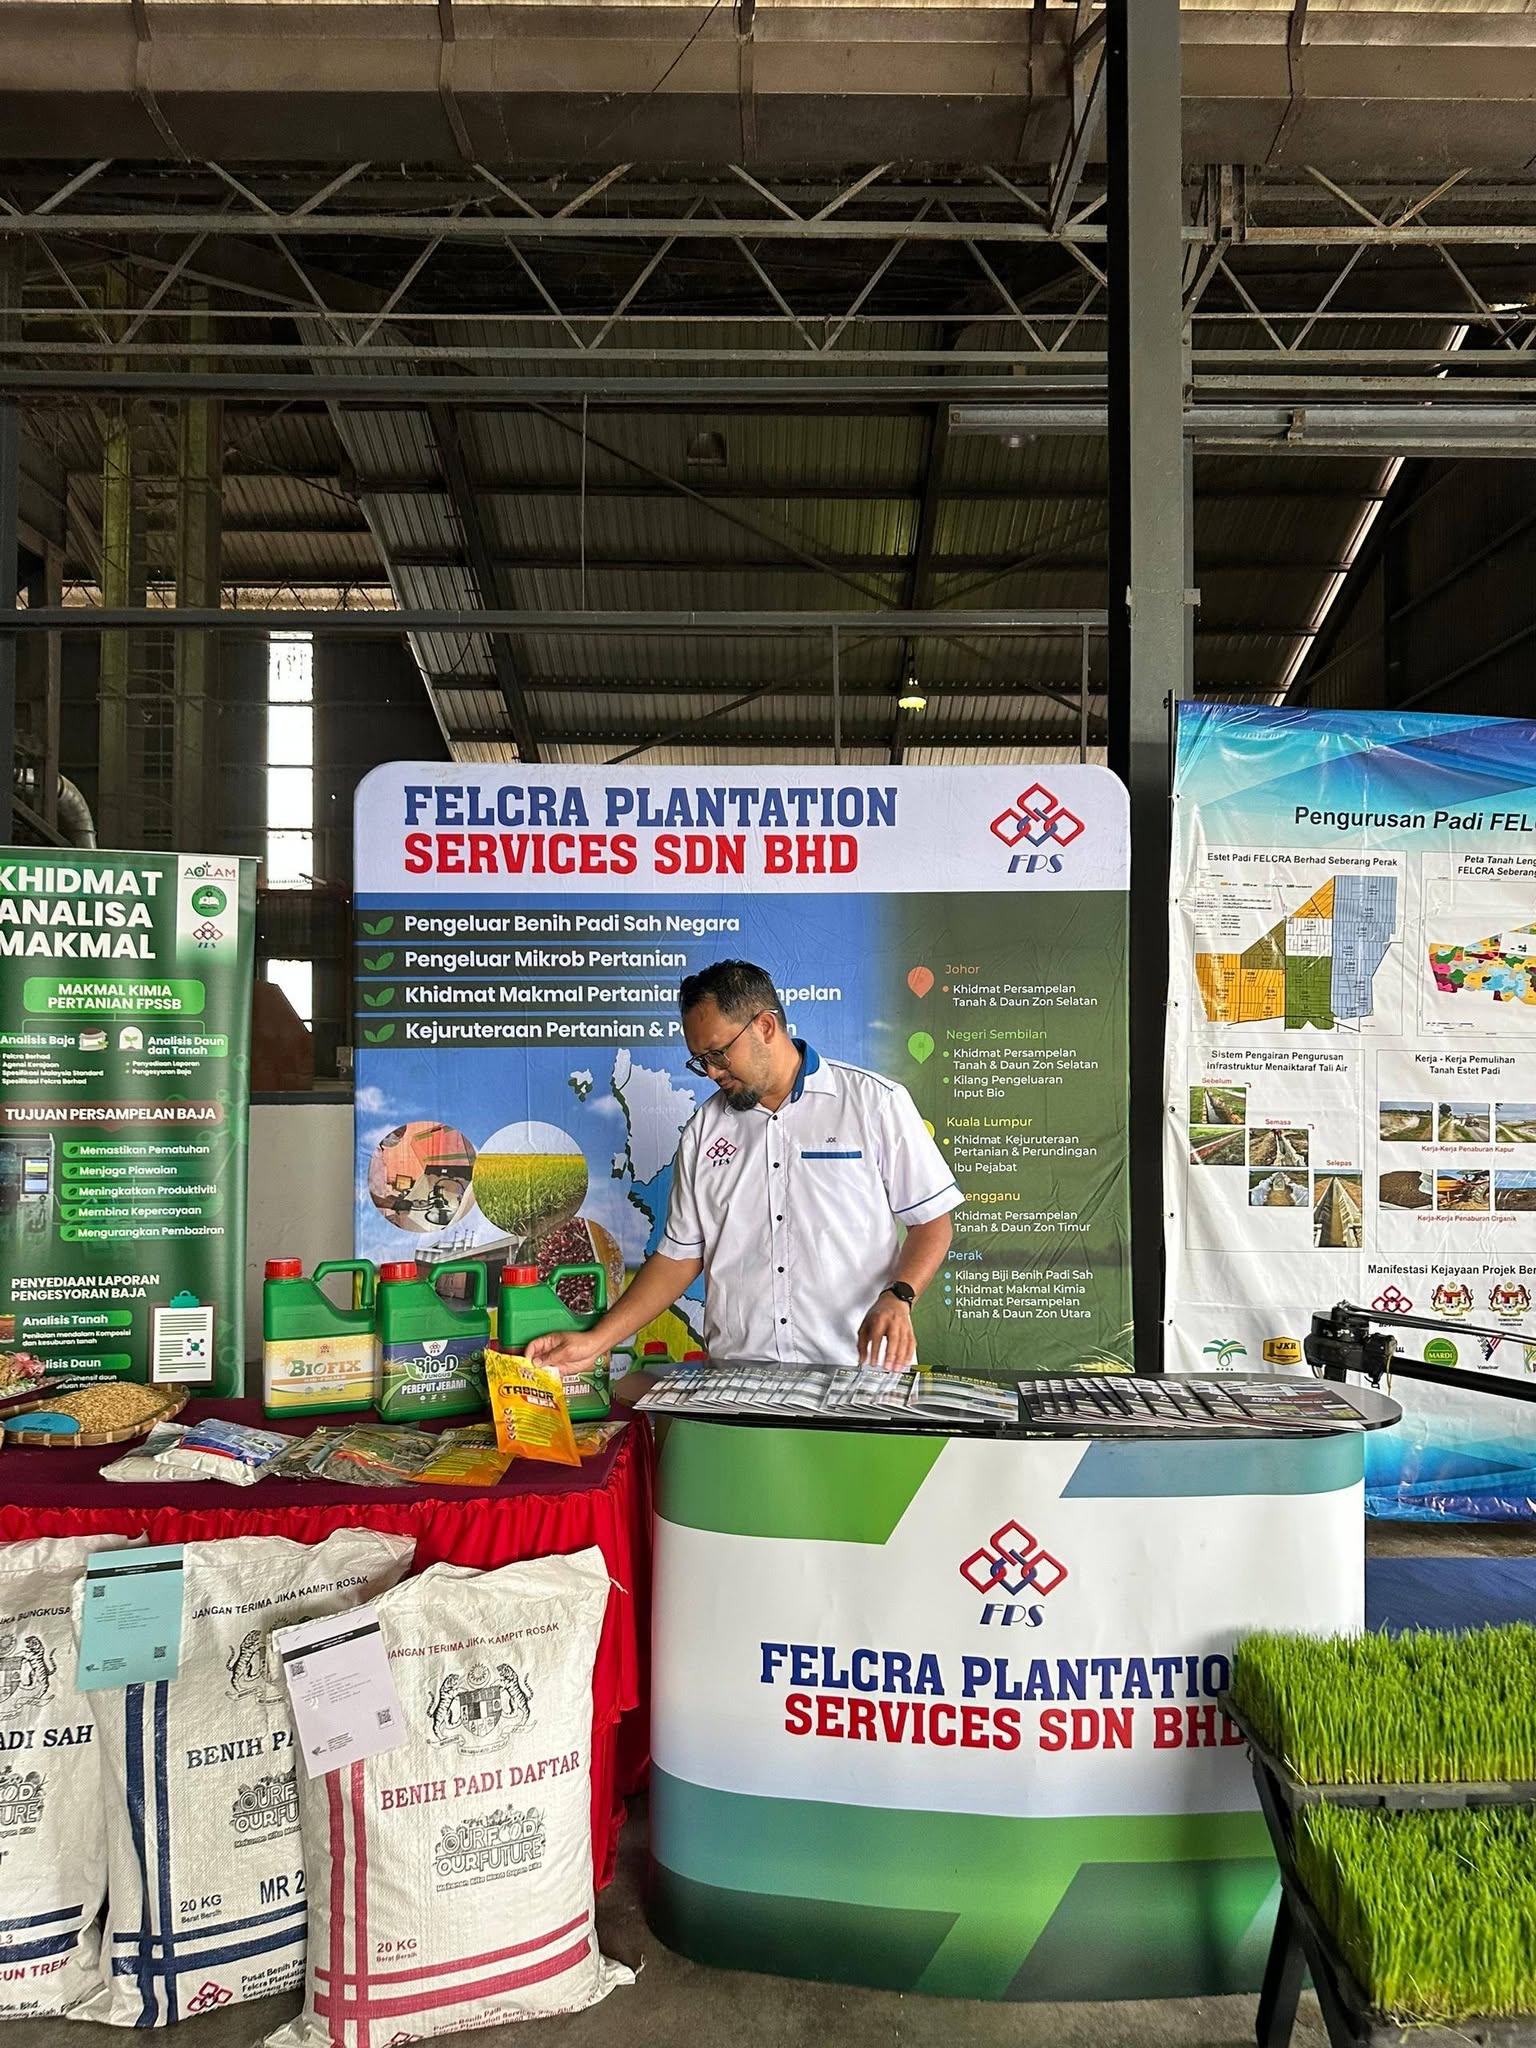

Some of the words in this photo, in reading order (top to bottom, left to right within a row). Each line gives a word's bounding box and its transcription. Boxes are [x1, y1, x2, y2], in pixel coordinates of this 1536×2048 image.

[404, 786, 589, 827] FELCRA
[605, 786, 898, 827] PLANTATION
[1295, 806, 1425, 829] Pengurusan
[1433, 811, 1482, 830] Padi
[404, 833, 637, 874] SERVICES
[654, 834, 746, 874] SDN
[763, 834, 858, 874] BHD
[1007, 853, 1065, 874] FPS
[1207, 853, 1230, 862] Estet
[1232, 853, 1251, 863] Padi
[1253, 854, 1292, 865] FELCRA
[1294, 855, 1325, 865] Berhad
[1327, 856, 1371, 867] Seberang
[1373, 857, 1397, 867] Perak
[1464, 855, 1484, 864] Peta
[1487, 856, 1514, 865] Tanah
[1458, 867, 1494, 875] FELCRA
[0, 866, 163, 896] KHIDMAT
[0, 898, 153, 928] ANALISA
[404, 915, 510, 937] Pengeluar
[514, 914, 571, 932] Benih
[575, 914, 620, 931] Padi
[623, 915, 662, 931] Sah
[666, 916, 740, 936] Negara
[0, 930, 156, 959] MAKMAL
[405, 951, 511, 973] Pengeluar
[514, 950, 585, 967] Mikrob
[589, 950, 687, 967] Pertanian
[946, 965, 980, 975] Johor
[58, 983, 127, 997] MAKMAL
[129, 985, 172, 997] KIMIA
[405, 986, 495, 1003] Khidmat
[500, 986, 583, 1003] Makmal
[953, 984, 1001, 994] Khidmat
[1003, 984, 1076, 995] Persampelan
[48, 998, 134, 1010] PERTANIAN
[136, 998, 182, 1010] FPSSB
[953, 997, 987, 1007] Tanah
[1000, 997, 1030, 1006] Daun
[1032, 997, 1054, 1006] Zon
[1056, 997, 1098, 1006] Selatan
[406, 1022, 542, 1044] Kejuruteraan
[547, 1021, 645, 1038] Pertanian
[649, 1022, 664, 1038] &
[946, 1030, 987, 1042] Negeri
[989, 1029, 1047, 1040] Sembilan
[0, 1036, 48, 1045] Analisis
[49, 1036, 75, 1047] Baja
[148, 1036, 195, 1046] Analisis
[196, 1037, 225, 1046] Daun
[148, 1046, 170, 1055] dan
[172, 1046, 208, 1056] Tanah
[953, 1049, 1001, 1058] Khidmat
[1003, 1049, 1076, 1059] Persampelan
[1211, 1050, 1242, 1060] Sistem
[1245, 1051, 1289, 1062] Pengairan
[1292, 1052, 1344, 1062] Pengurusan
[953, 1061, 987, 1070] Tanah
[1000, 1061, 1030, 1069] Daun
[1033, 1061, 1054, 1069] Zon
[1056, 1060, 1098, 1069] Selatan
[1415, 1054, 1437, 1065] Kerja
[1445, 1055, 1467, 1065] Kerja
[1469, 1055, 1515, 1065] Pemulihan
[1207, 1061, 1263, 1071] Infrastruktur
[1265, 1062, 1317, 1072] Menaiktaraf
[1319, 1063, 1334, 1072] Tali
[1336, 1063, 1348, 1072] Air
[1430, 1066, 1455, 1074] Tanah
[1457, 1066, 1478, 1075] Estet
[1481, 1066, 1500, 1075] Padi
[953, 1075, 989, 1086] Kilang
[991, 1075, 1063, 1087] Pengeluaran
[953, 1088, 984, 1100] Input
[987, 1088, 1005, 1097] Bio
[5, 1108, 67, 1120] TUJUAN
[70, 1108, 175, 1120] PERSAMPELAN
[177, 1108, 216, 1120] BAJA
[946, 1117, 980, 1127] Kuala
[984, 1117, 1033, 1129] Lumpur
[1005, 1135, 1079, 1146] Kejuruteraan
[80, 1145, 146, 1155] Memastikan
[148, 1144, 209, 1154] Pematuhan
[954, 1147, 1009, 1156] Pertanian
[1022, 1147, 1097, 1158] Perundingan
[79, 1165, 126, 1177] Menjaga
[128, 1165, 177, 1175] Piawaian
[954, 1162, 972, 1172] Ibu
[975, 1162, 1017, 1173] Pejabat
[79, 1185, 155, 1197] Meningkatkan
[157, 1184, 217, 1195] Produktiviti
[78, 1206, 129, 1216] Membina
[131, 1206, 202, 1217] Kepercayaan
[78, 1227, 160, 1238] Mengurangkan
[162, 1226, 224, 1235] Pembaziran
[1057, 1222, 1091, 1232] Timur
[948, 1250, 983, 1261] Perak
[955, 1271, 989, 1282] Kilang
[992, 1271, 1009, 1281] Biji
[1011, 1271, 1043, 1280] Benih
[1045, 1271, 1070, 1280] Padi
[1072, 1270, 1093, 1280] Sah
[1368, 1265, 1428, 1274] Manifestasi
[1431, 1265, 1479, 1276] Kejayaan
[1482, 1266, 1516, 1276] Projek
[11, 1276, 96, 1288] PENYEDIAAN
[98, 1275, 160, 1287] LAPORAN
[11, 1288, 109, 1301] PENGESYORAN
[111, 1288, 146, 1299] BAJA
[1006, 1285, 1051, 1294] Makmal
[1053, 1284, 1086, 1294] Kimia
[1060, 1309, 1091, 1318] Utara
[23, 1315, 70, 1326] Analisis
[71, 1314, 108, 1324] Tanah
[1276, 1342, 1297, 1350] JKR
[70, 1358, 101, 1368] Daun
[401, 1382, 436, 1395] PEREPUT
[436, 1379, 467, 1391] JERAMI
[192, 1607, 232, 1619] JANGAN
[235, 1598, 272, 1614] TERIMA
[275, 1591, 297, 1604] JIKA
[299, 1582, 333, 1597] KAMPIT
[336, 1576, 369, 1590] ROSAK
[979, 1603, 1045, 1628] FPS
[428, 1641, 465, 1655] TERIMA
[466, 1637, 486, 1648] JIKA
[488, 1631, 524, 1644] KAMPIT
[526, 1622, 560, 1635] ROSAK
[760, 1641, 948, 1696] FELCRA
[962, 1653, 1230, 1700] PLANTATIO
[785, 1693, 1021, 1751] SERVICES
[1039, 1706, 1134, 1751] SDN
[43, 1724, 94, 1747] SAH
[186, 1738, 264, 1768] BENIH
[381, 1780, 447, 1811] BENIH
[453, 1767, 503, 1798] PADI
[508, 1751, 581, 1788] DAFTAR
[260, 1875, 289, 1904] MR
[180, 1901, 197, 1912] 20
[201, 1894, 222, 1908] KG
[376, 1941, 393, 1951] 20
[397, 1938, 417, 1950] KG
[31, 1956, 71, 1977] TREK
